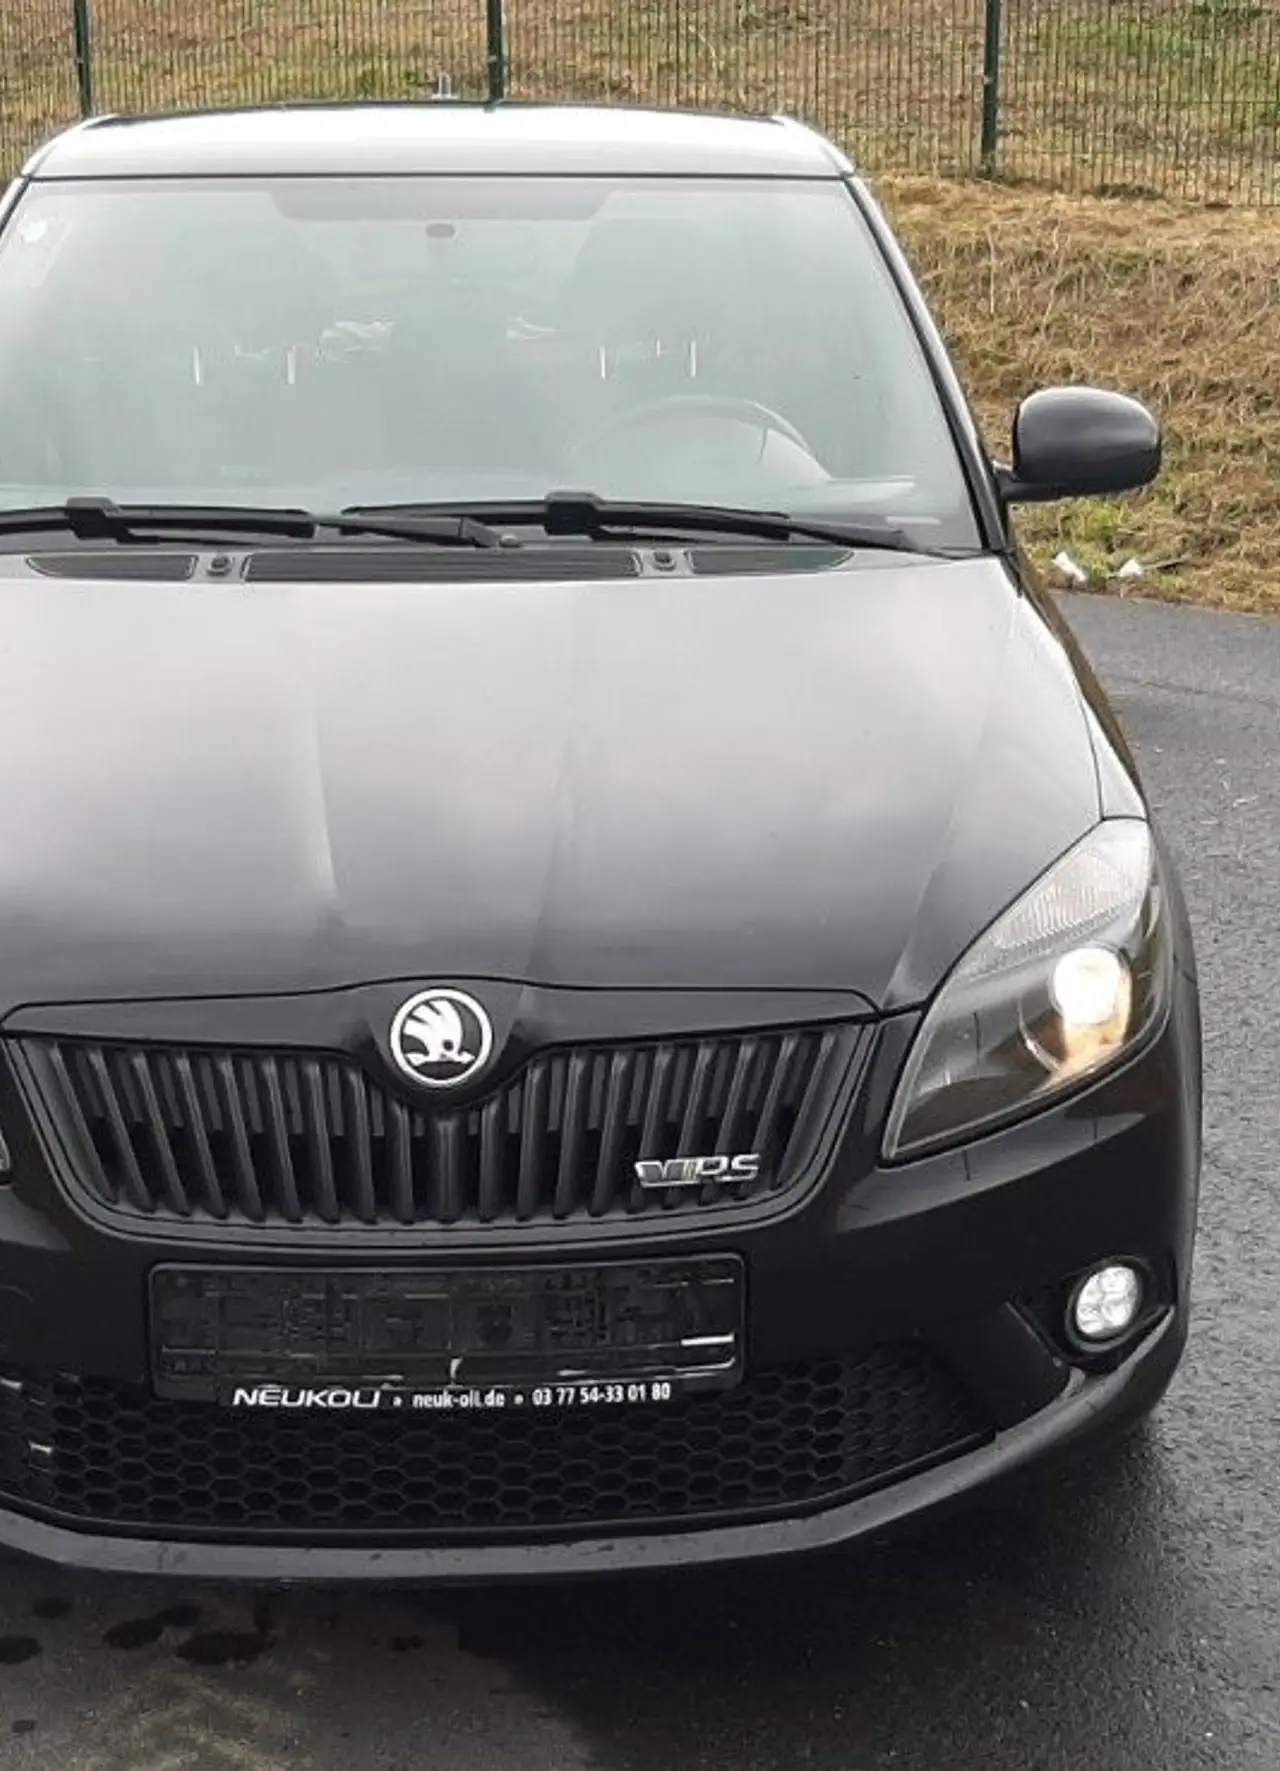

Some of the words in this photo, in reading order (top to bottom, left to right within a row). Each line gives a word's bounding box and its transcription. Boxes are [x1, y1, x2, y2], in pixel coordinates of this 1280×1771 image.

[532, 1387, 552, 1406] 03
[556, 1387, 575, 1405] 77
[580, 1384, 624, 1404] 54-33
[628, 1384, 646, 1403] 01
[652, 1382, 671, 1401] 80
